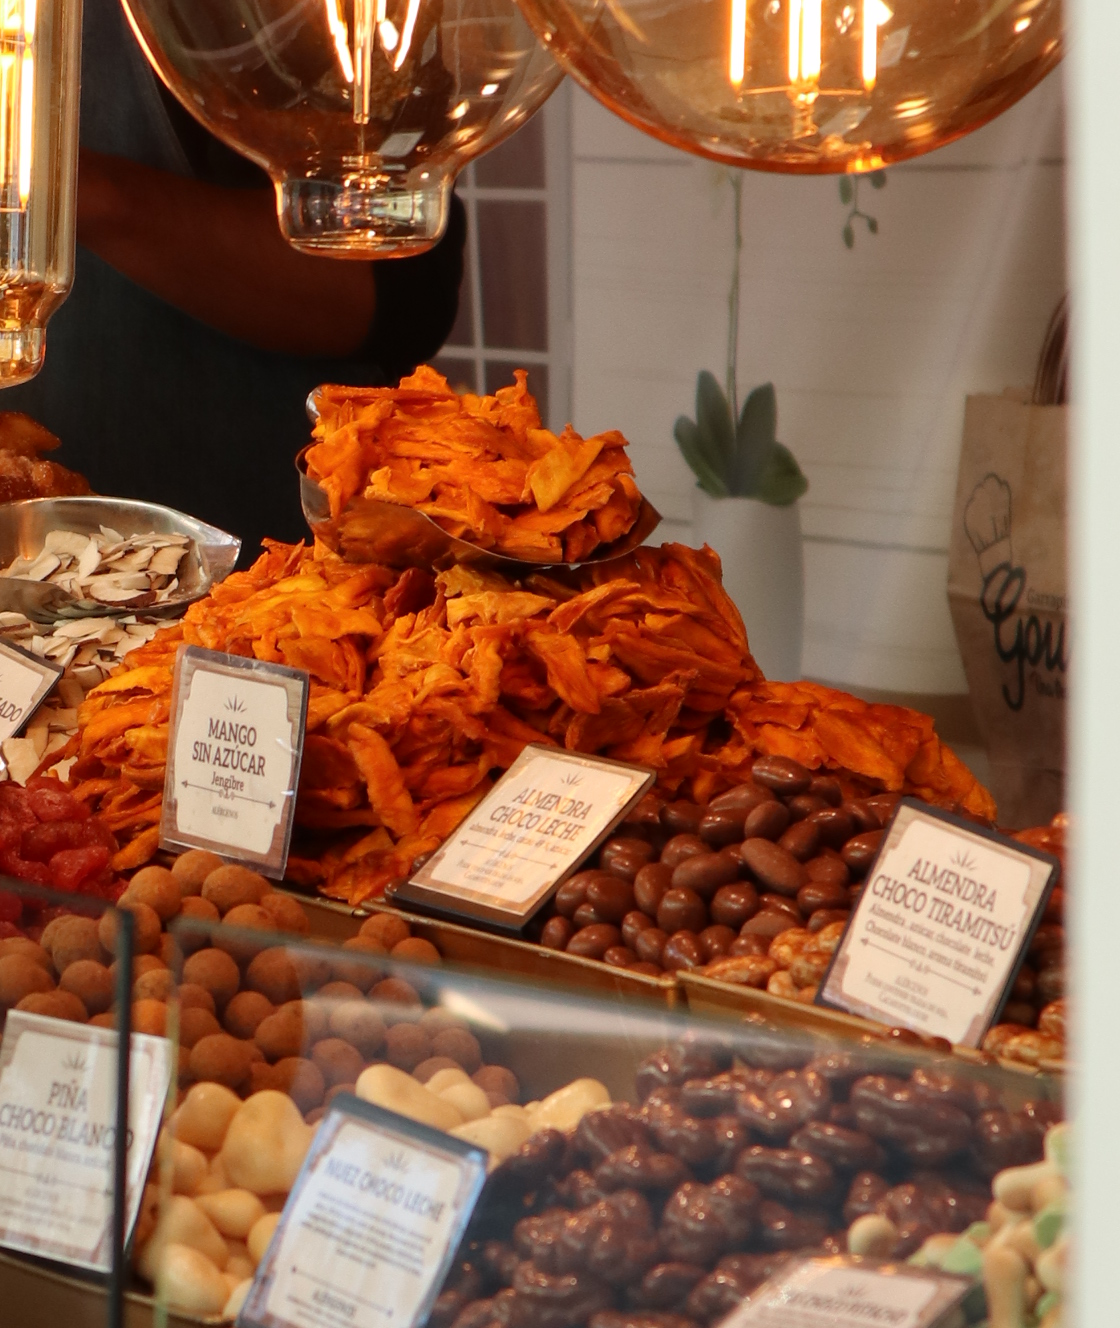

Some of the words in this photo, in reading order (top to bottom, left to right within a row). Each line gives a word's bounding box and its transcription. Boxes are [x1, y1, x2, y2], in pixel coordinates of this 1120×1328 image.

[207, 718, 257, 747] MANGO
[192, 741, 212, 763] SIN
[213, 743, 266, 776] AZÚCAR
[211, 771, 244, 795] Jengibre
[512, 787, 595, 820] ALMENDRA
[487, 805, 544, 831] CHOCO
[534, 816, 587, 841] LECHE
[906, 856, 998, 913] ALMENDRA
[869, 872, 930, 914] CHOCO
[925, 896, 1017, 953] TIRAMITSÚ
[46, 1075, 93, 1113] PIÑA
[356, 1170, 406, 1205] CHOCO
